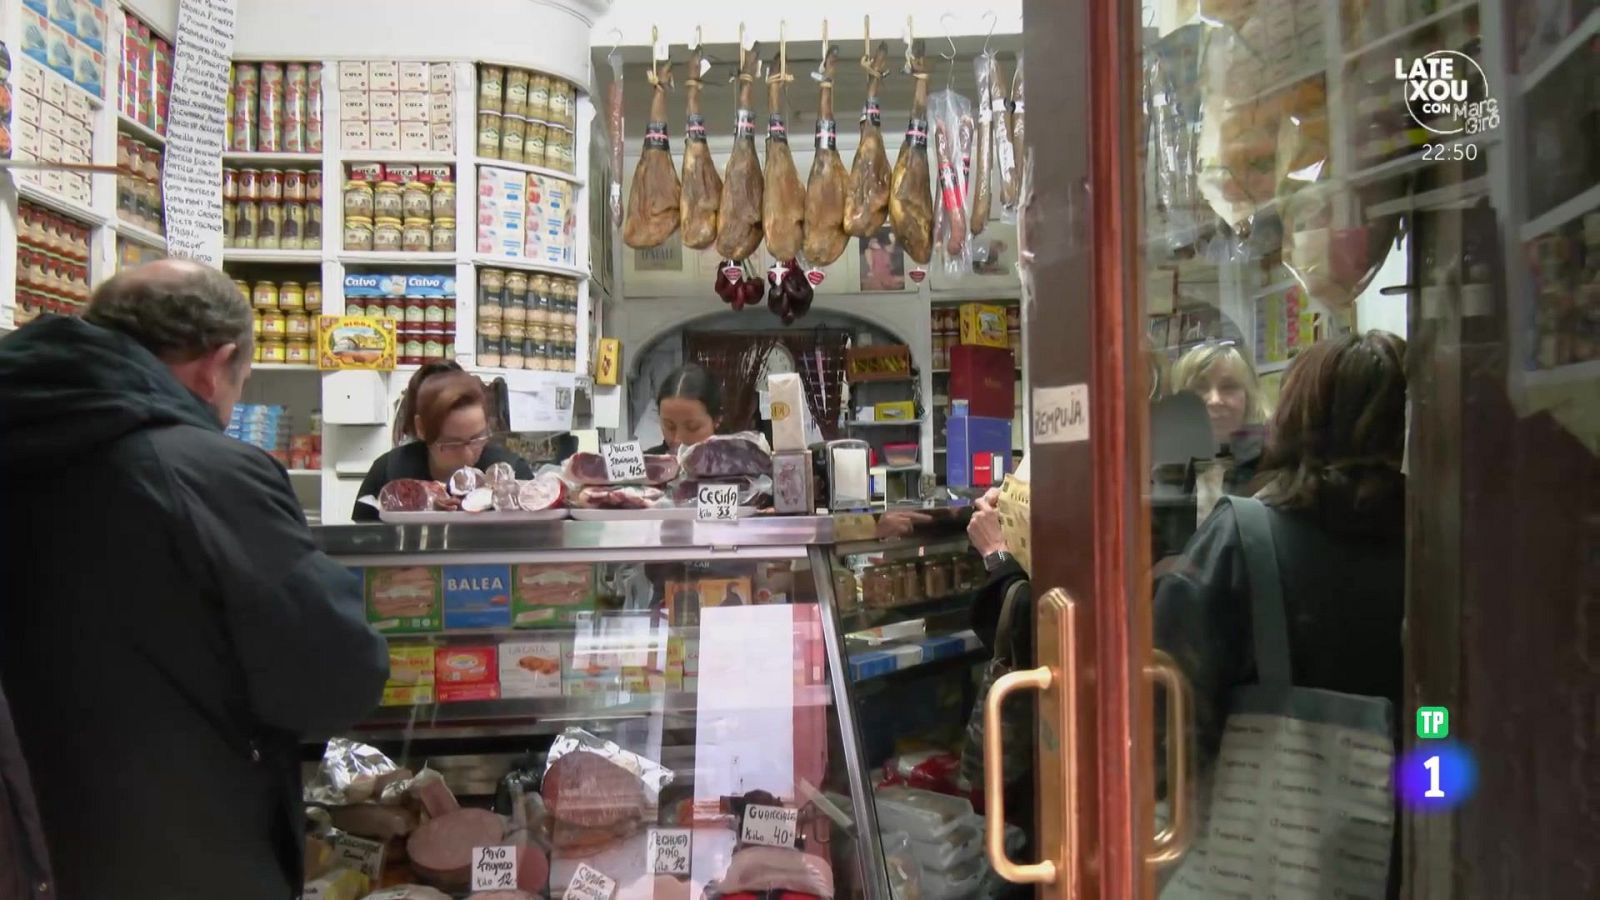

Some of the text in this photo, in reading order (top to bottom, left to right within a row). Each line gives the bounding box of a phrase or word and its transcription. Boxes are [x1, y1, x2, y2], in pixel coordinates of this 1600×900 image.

[345, 276, 376, 287] Calvo
[408, 277, 440, 287] Calvo
[447, 577, 503, 591] BALEA
